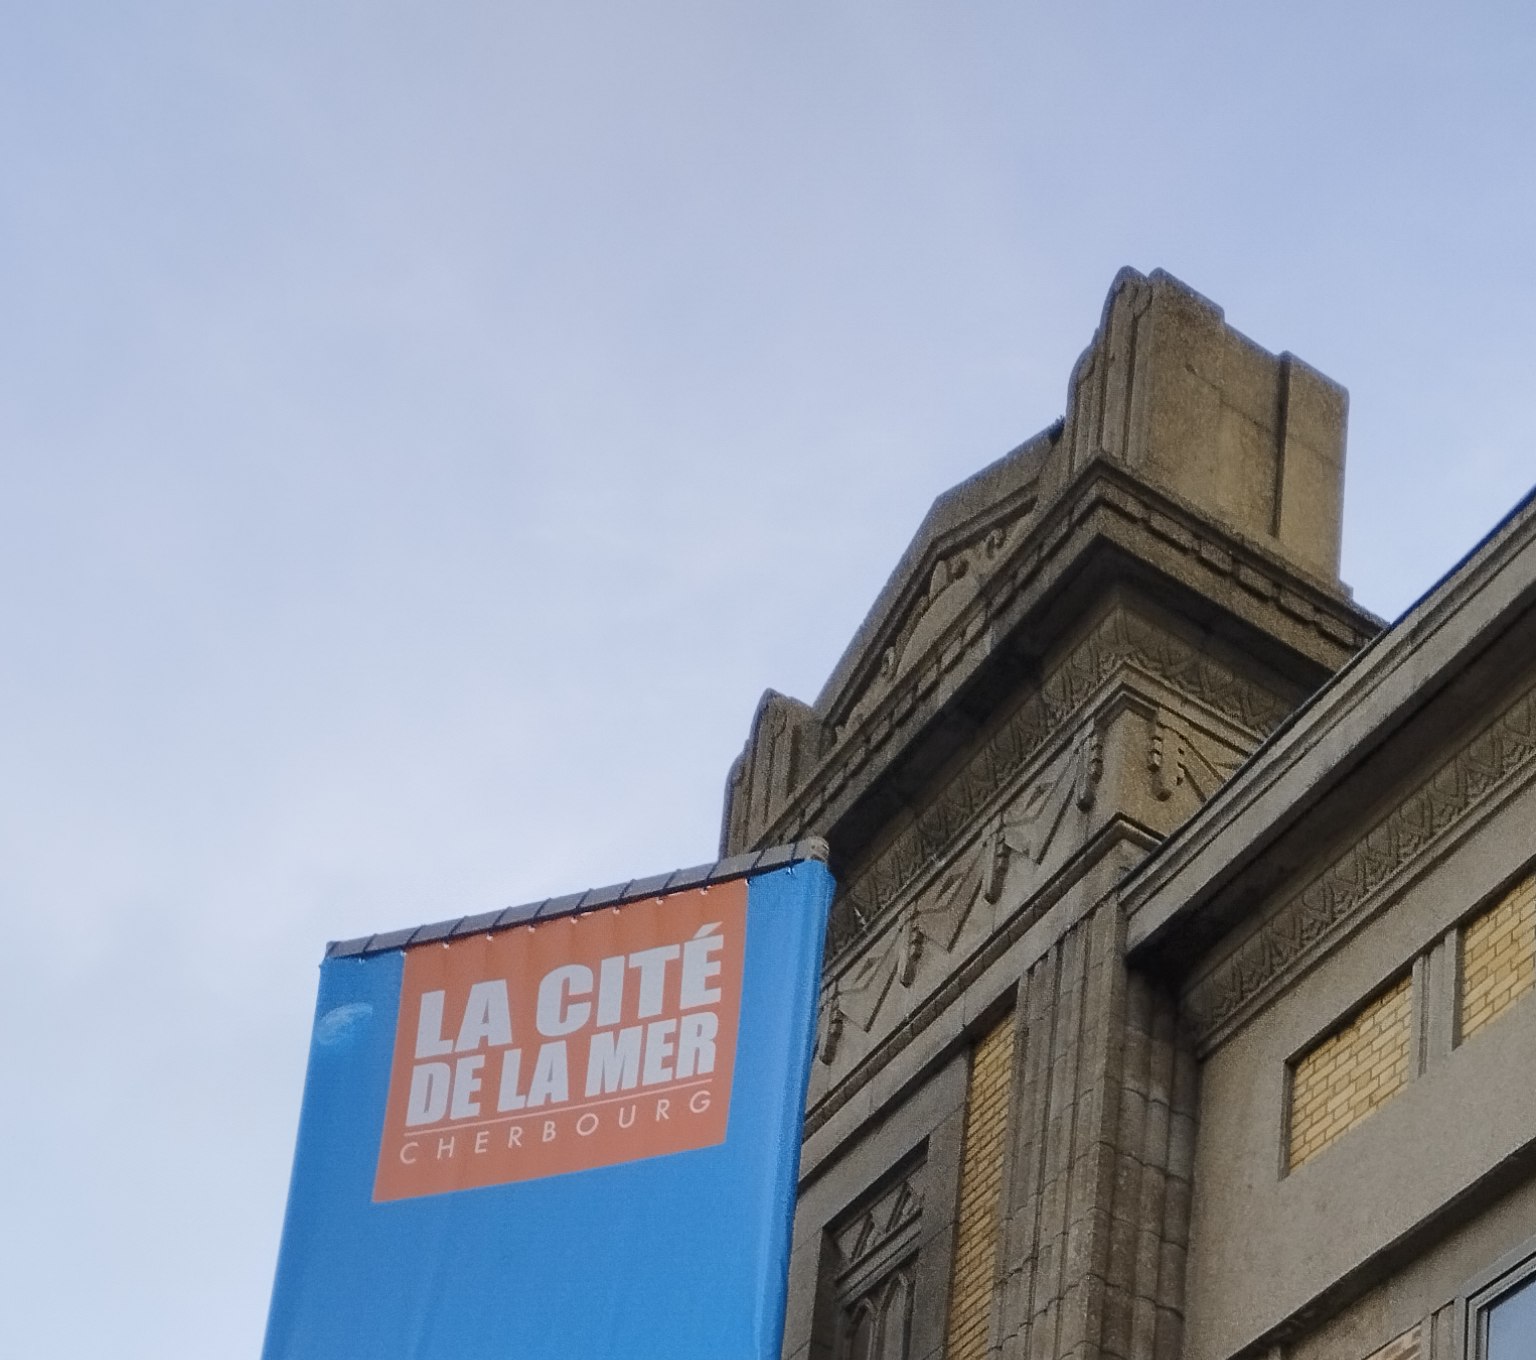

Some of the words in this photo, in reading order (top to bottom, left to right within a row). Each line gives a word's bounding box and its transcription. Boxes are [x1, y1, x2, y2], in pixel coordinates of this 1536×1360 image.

[414, 979, 513, 1059] LA
[535, 921, 724, 1037] CITÉ
[400, 1090, 711, 1164] CHERBOURG
[405, 1055, 485, 1127] DE
[497, 1040, 568, 1113] LA
[584, 1011, 719, 1097] MER
